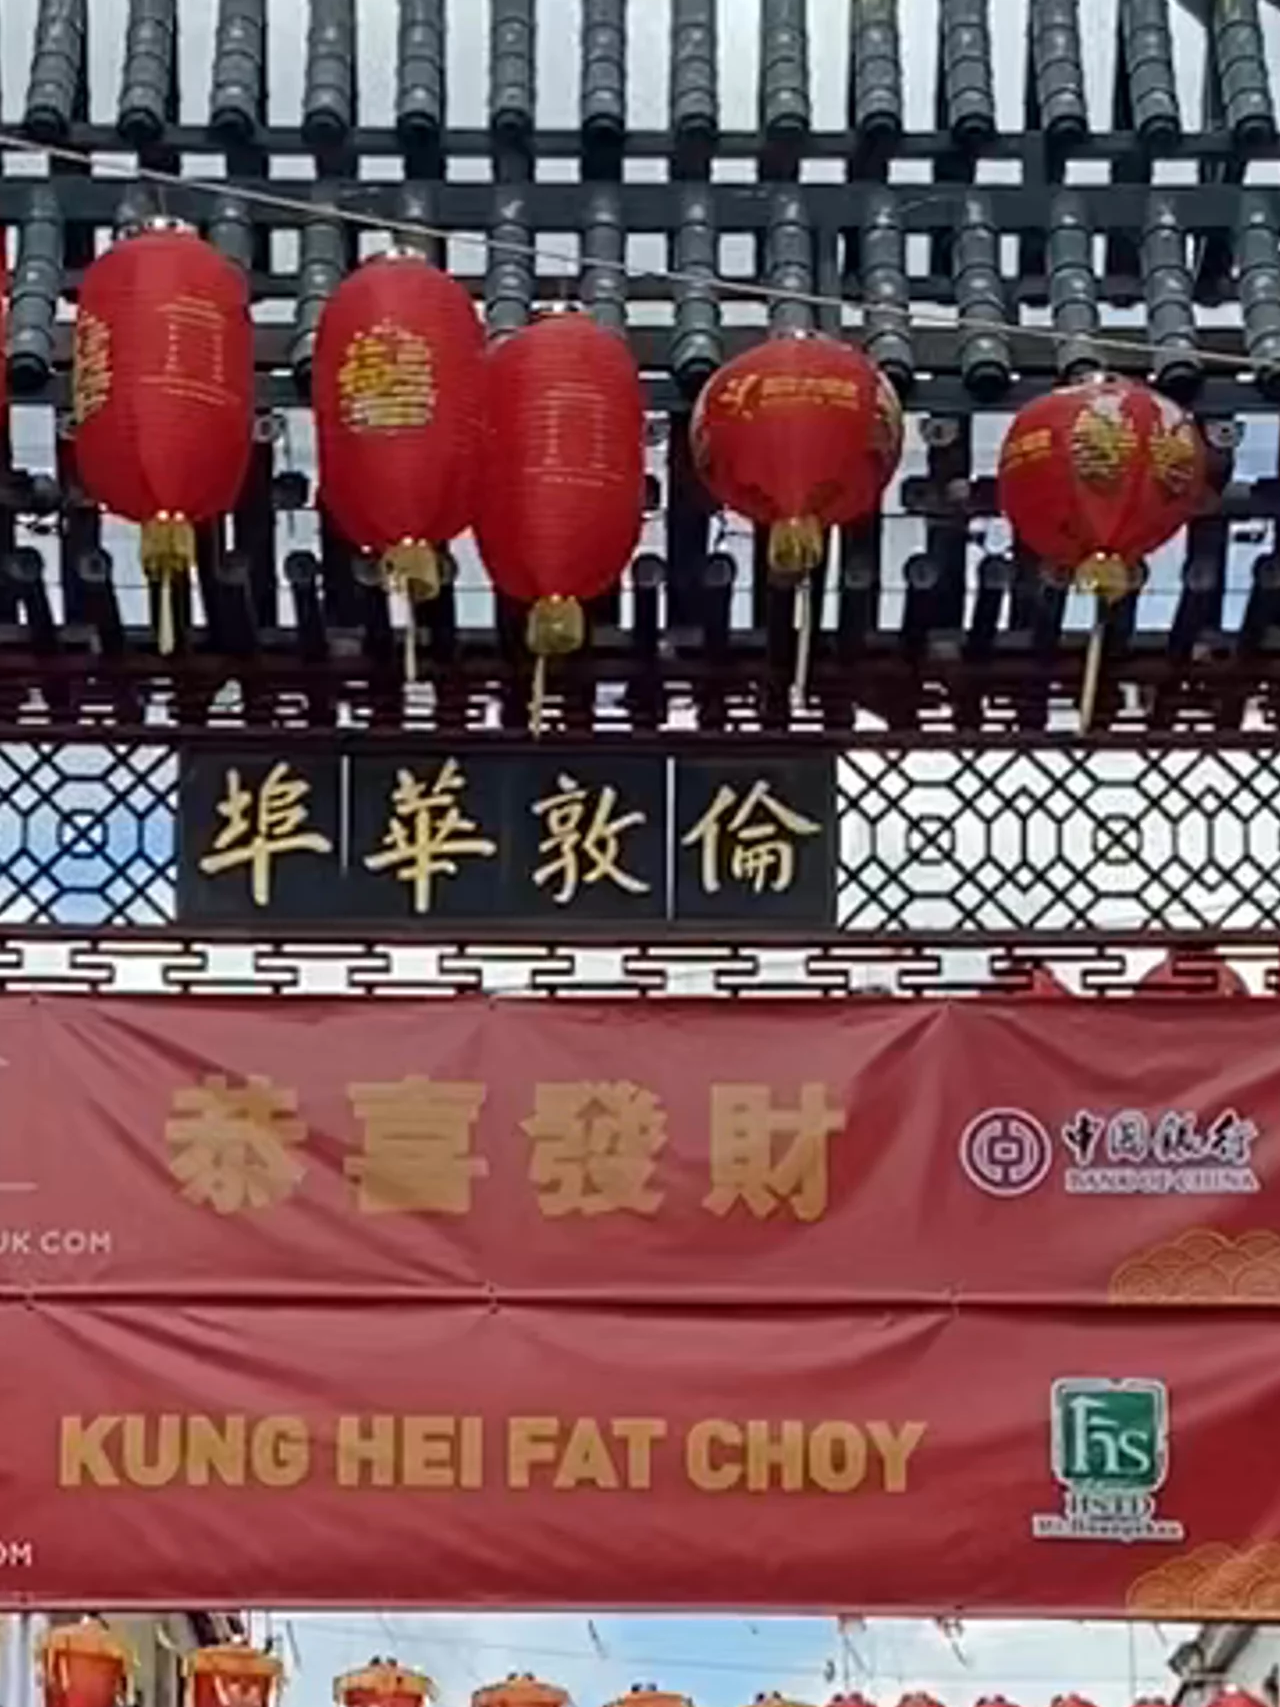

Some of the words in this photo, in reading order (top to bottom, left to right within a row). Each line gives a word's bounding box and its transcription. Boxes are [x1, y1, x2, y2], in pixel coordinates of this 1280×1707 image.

[165, 1074, 848, 1221] 恭喜發財
[58, 1415, 310, 1487] KUNG
[335, 1416, 483, 1489] HEI
[508, 1418, 666, 1490] FAT
[685, 1420, 928, 1493] CHOY
